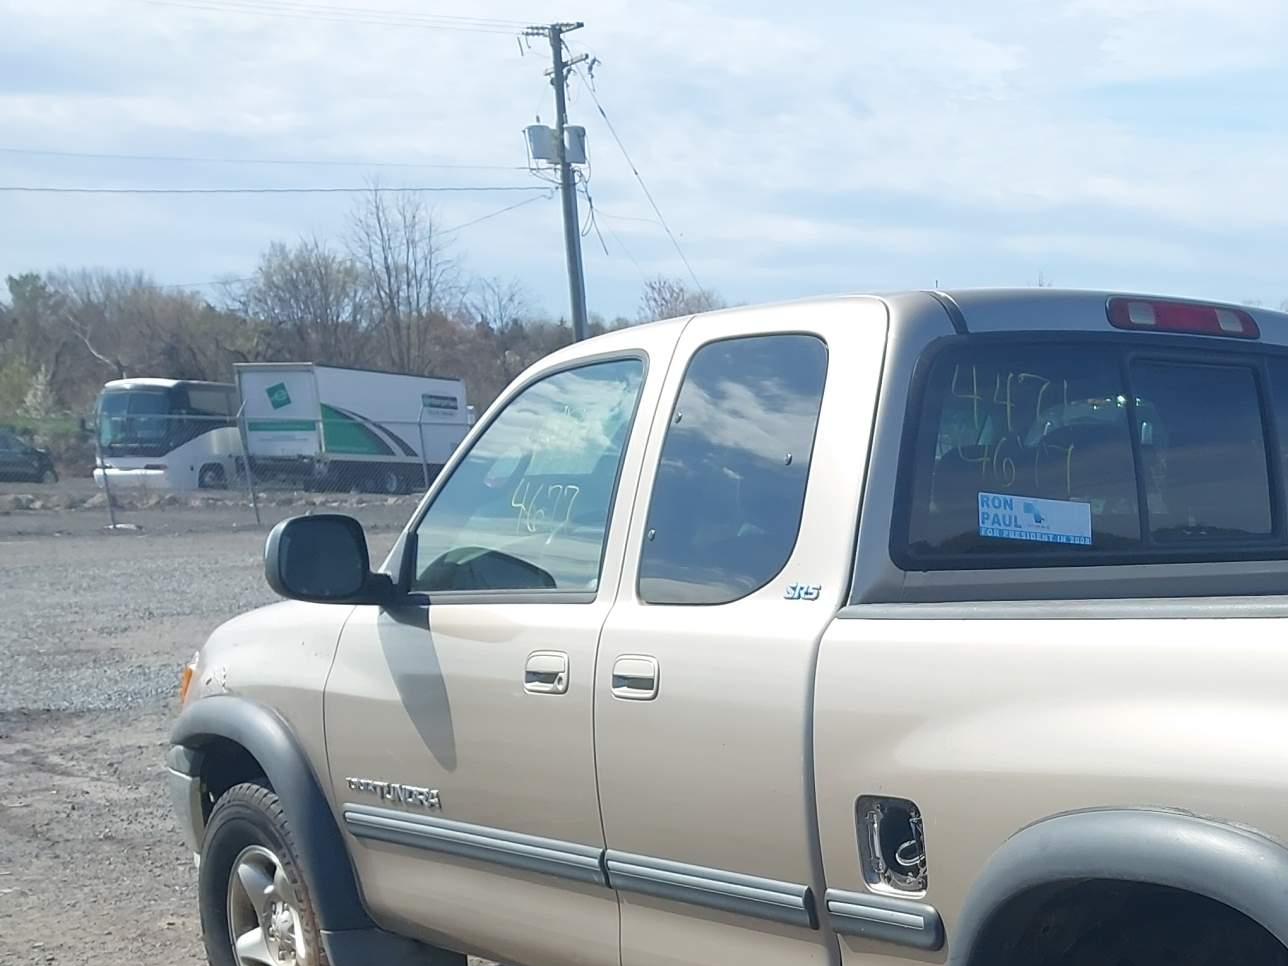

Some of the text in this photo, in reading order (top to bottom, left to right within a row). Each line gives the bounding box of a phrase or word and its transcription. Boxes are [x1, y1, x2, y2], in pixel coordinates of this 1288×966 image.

[980, 494, 1014, 512] RON
[980, 511, 1022, 529] PAUL
[981, 528, 1000, 538] FOR
[1003, 529, 1054, 542] PRESIDENT
[784, 583, 822, 601] SR5
[374, 779, 442, 809] TUNDRA
